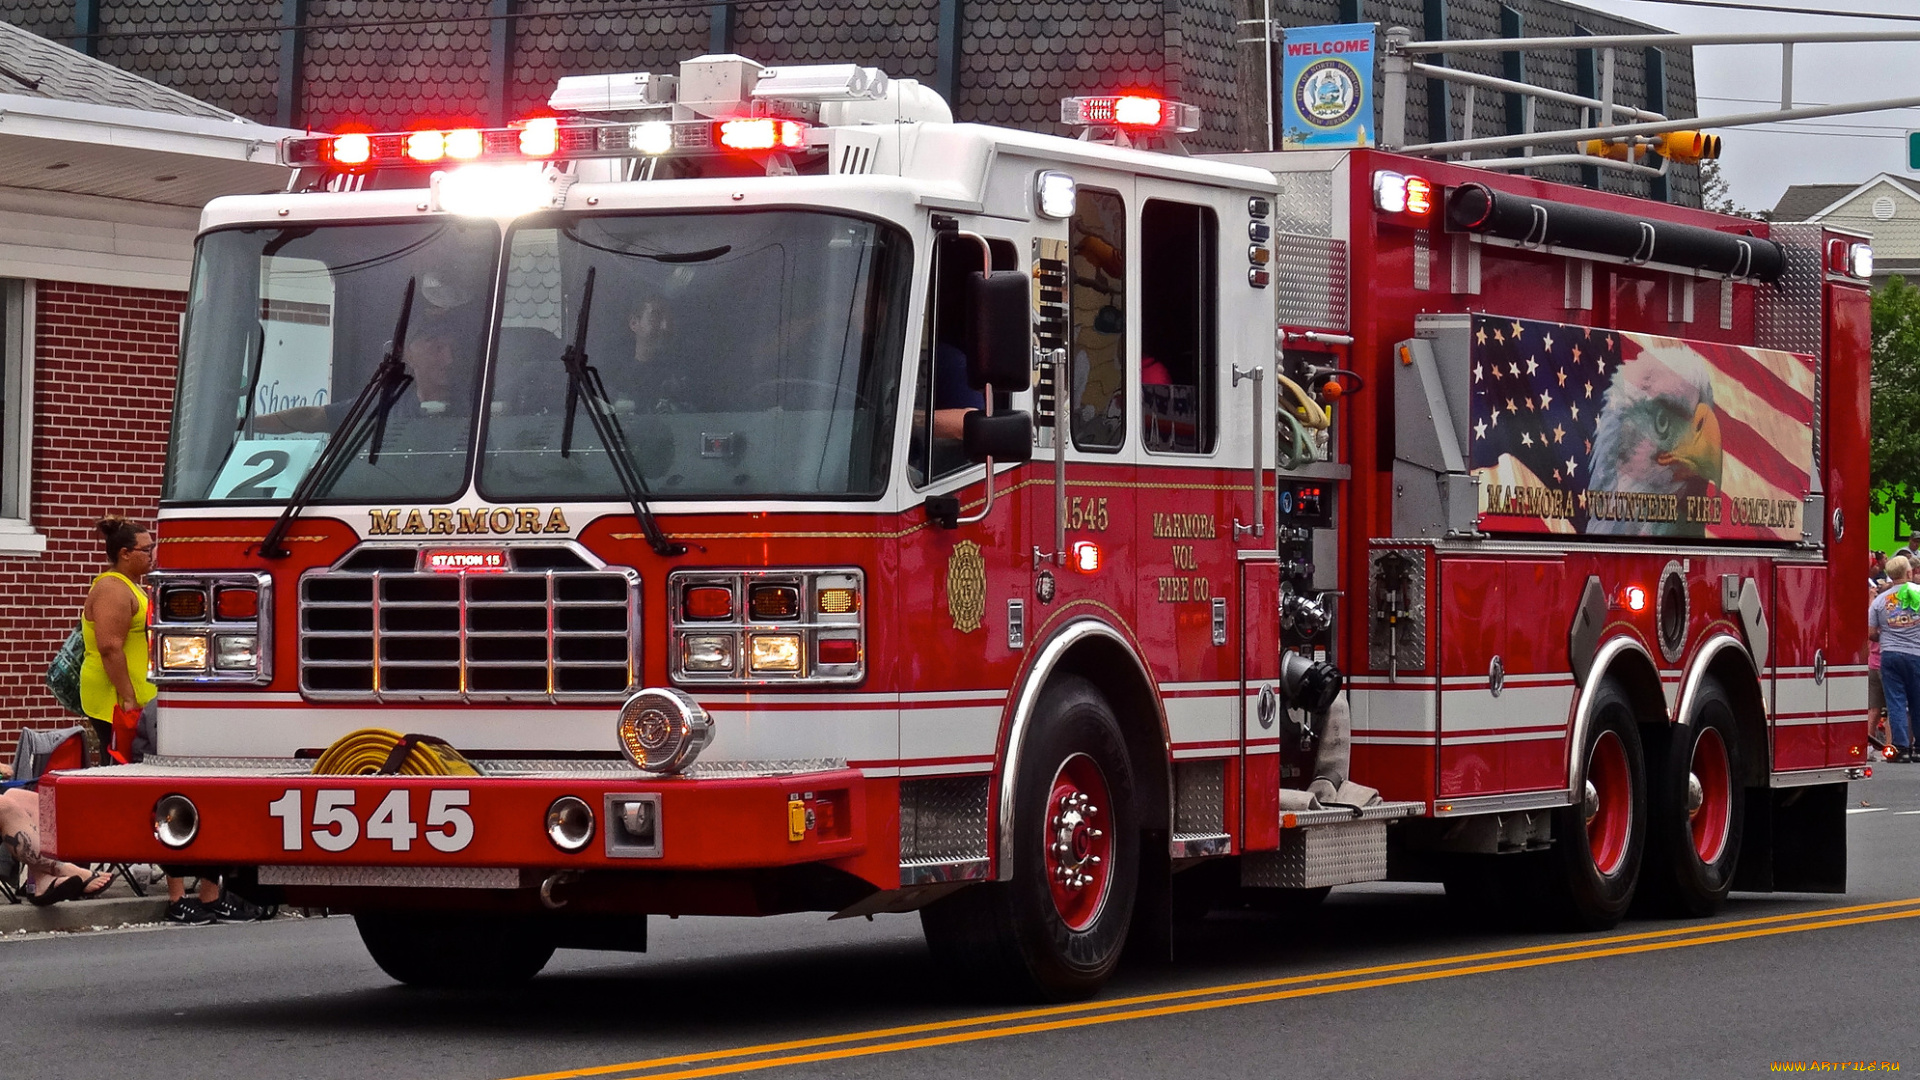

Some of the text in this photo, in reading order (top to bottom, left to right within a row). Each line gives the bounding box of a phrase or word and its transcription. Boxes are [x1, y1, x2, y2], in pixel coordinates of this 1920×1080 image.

[1287, 39, 1370, 56] WELCOME
[1310, 61, 1335, 73] NORTH
[1325, 111, 1351, 126] JERSEY
[225, 450, 290, 498] 2
[1487, 484, 1798, 529] MARMORA VOLUNTEER FIRE COMPANY
[368, 507, 570, 535] MARMORA
[1153, 513, 1216, 539] MARMORA
[432, 555, 500, 566] STATION 15
[1172, 545, 1198, 570] VOL.
[1158, 577, 1189, 602] FIRE
[269, 789, 475, 852] 1545
